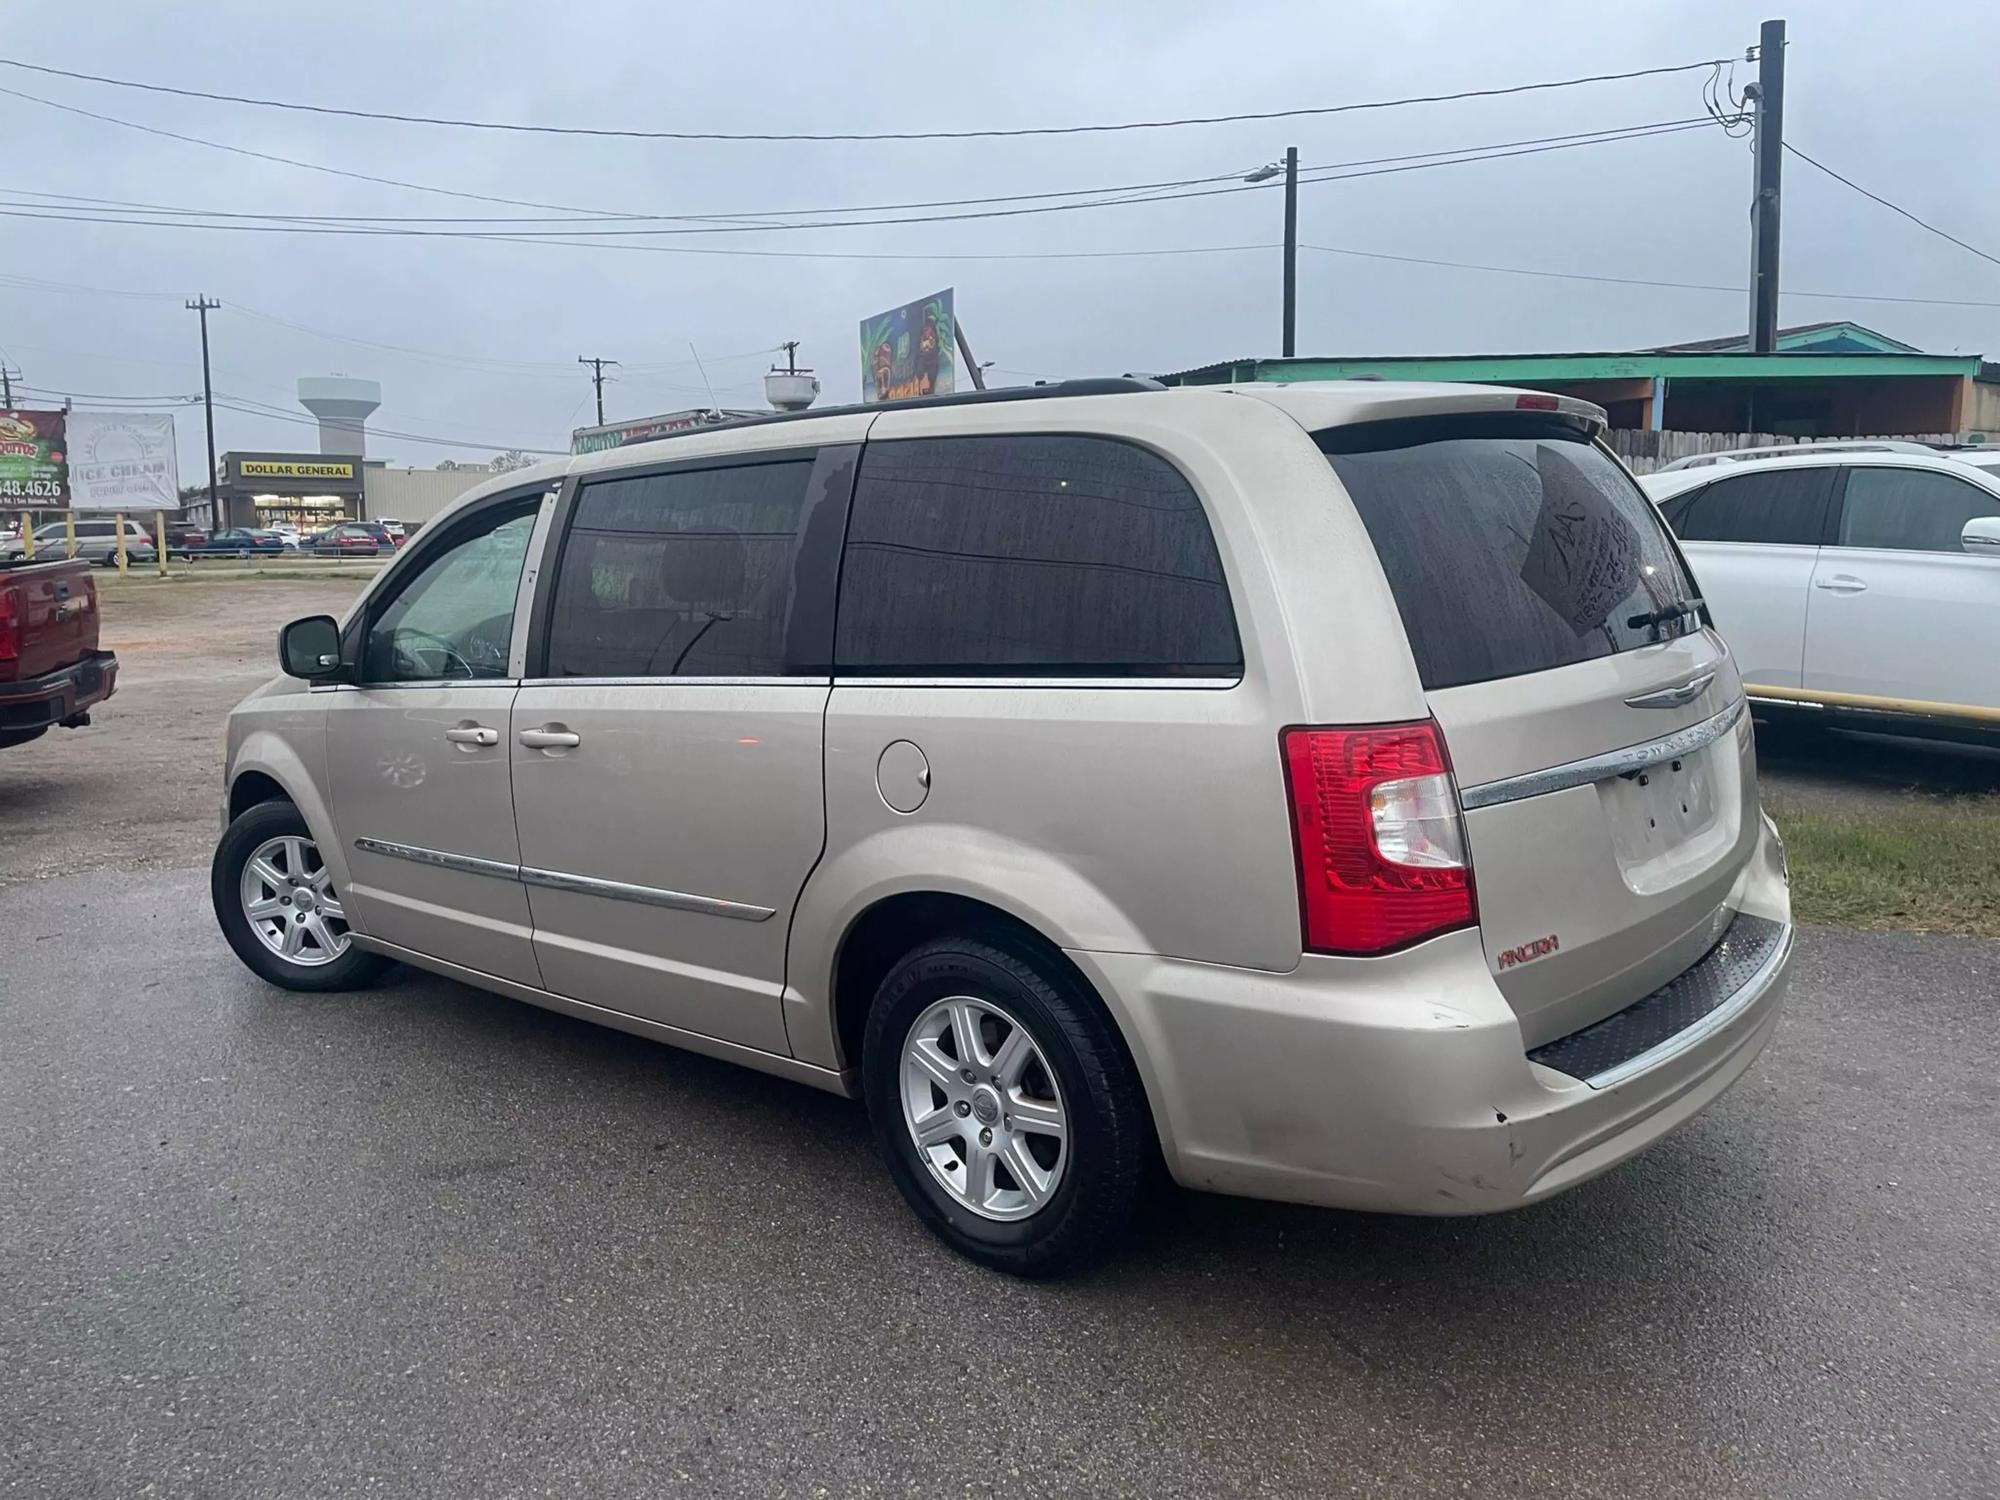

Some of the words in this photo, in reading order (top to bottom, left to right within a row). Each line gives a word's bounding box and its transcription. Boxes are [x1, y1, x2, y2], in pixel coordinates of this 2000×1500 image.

[245, 464, 293, 475] DOLLAR
[297, 466, 350, 476] GENERAL
[0, 480, 61, 496] 48.4626
[1497, 934, 1560, 970] ANCIRA
